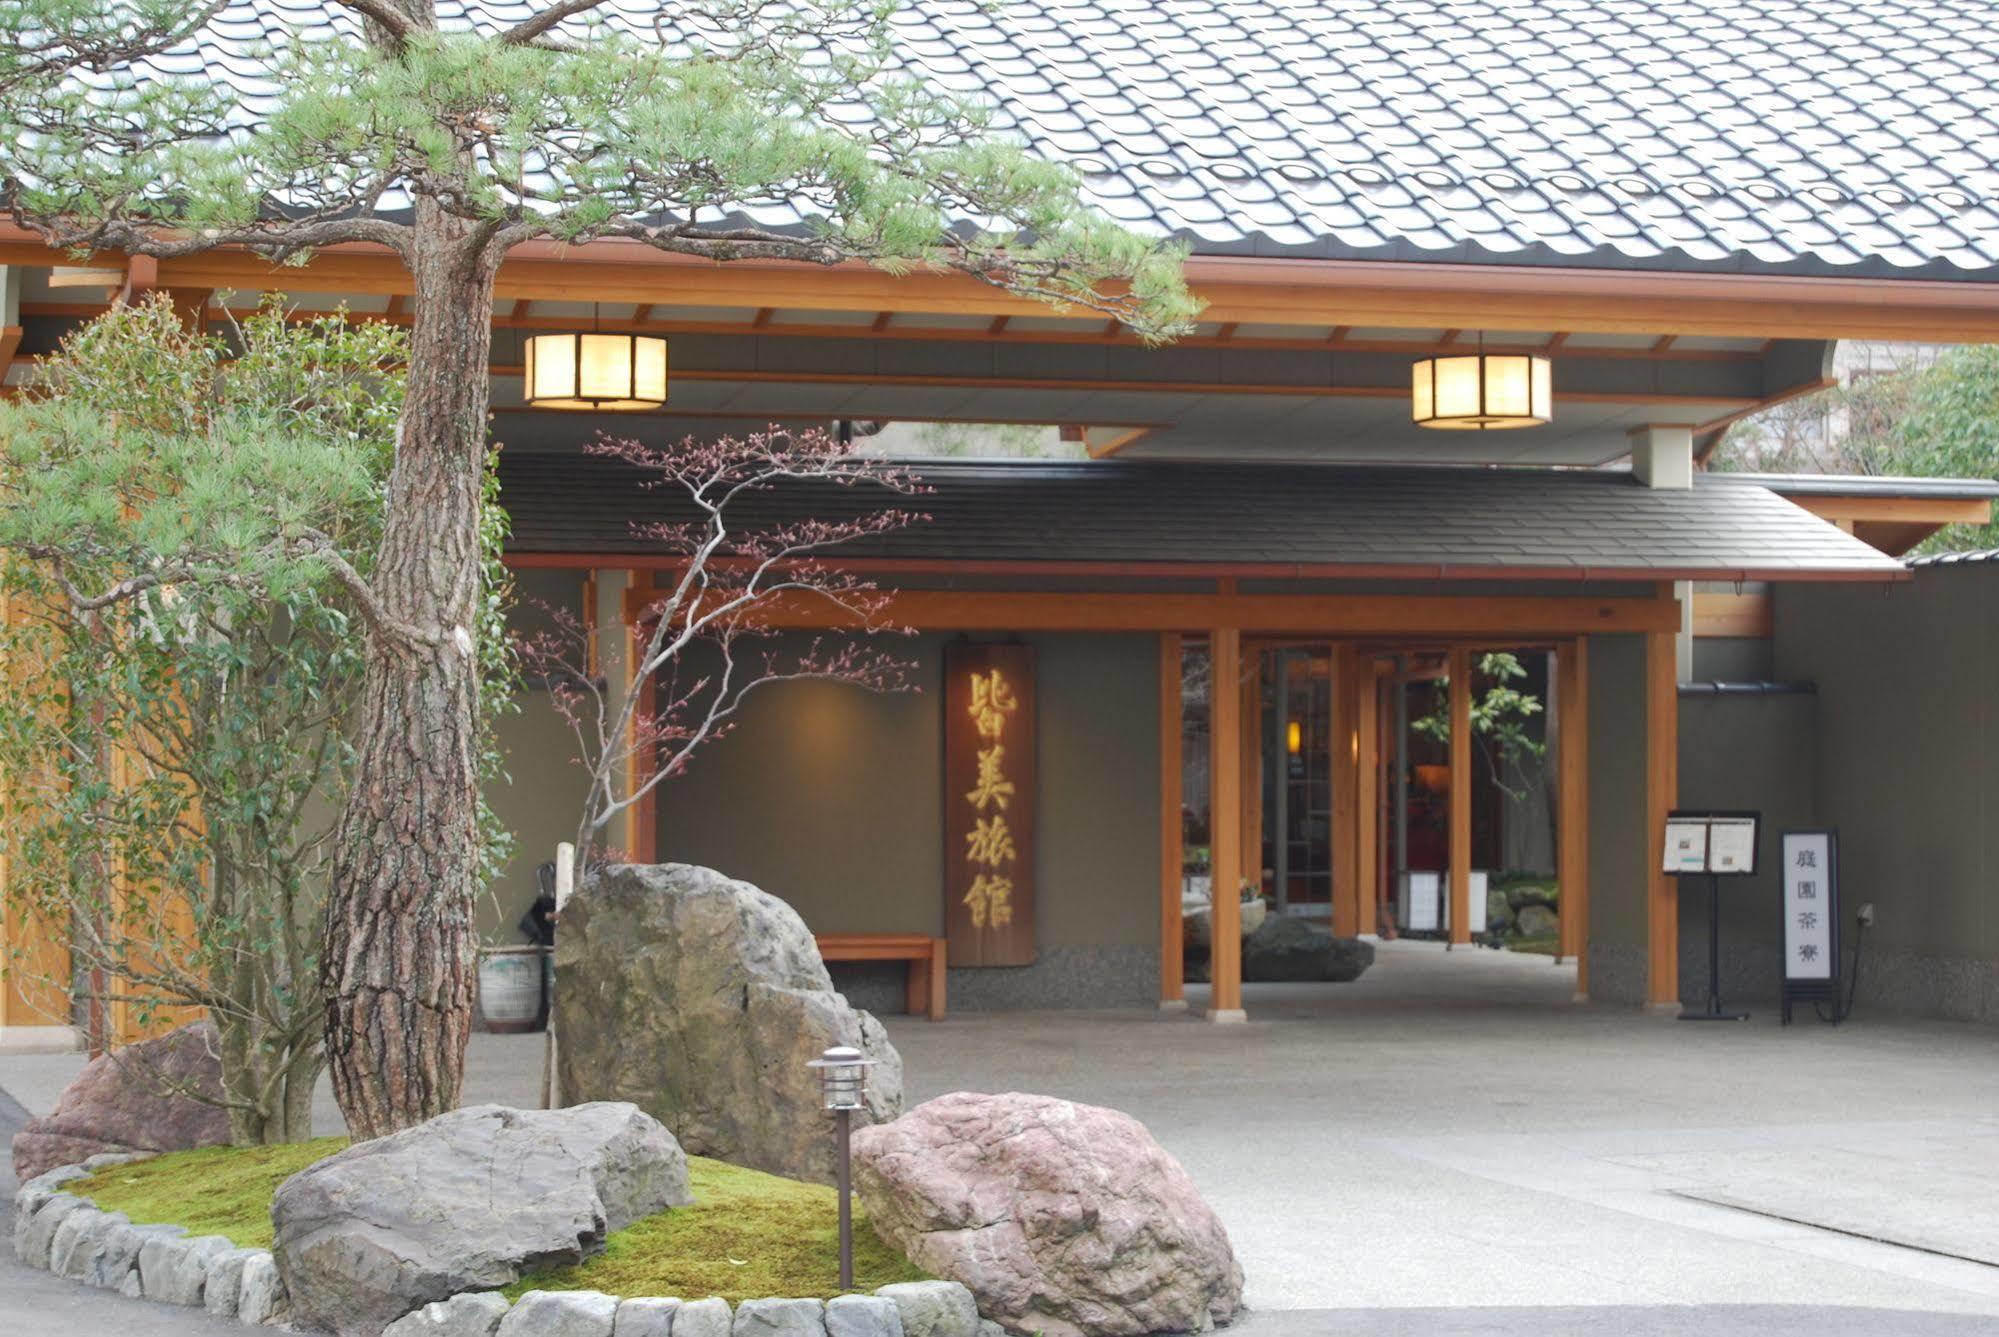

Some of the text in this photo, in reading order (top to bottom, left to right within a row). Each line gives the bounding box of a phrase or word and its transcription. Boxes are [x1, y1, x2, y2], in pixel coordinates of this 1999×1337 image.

[963, 669, 1017, 929] 皆美旅館
[1796, 850, 1818, 962] 庭園茶寮
